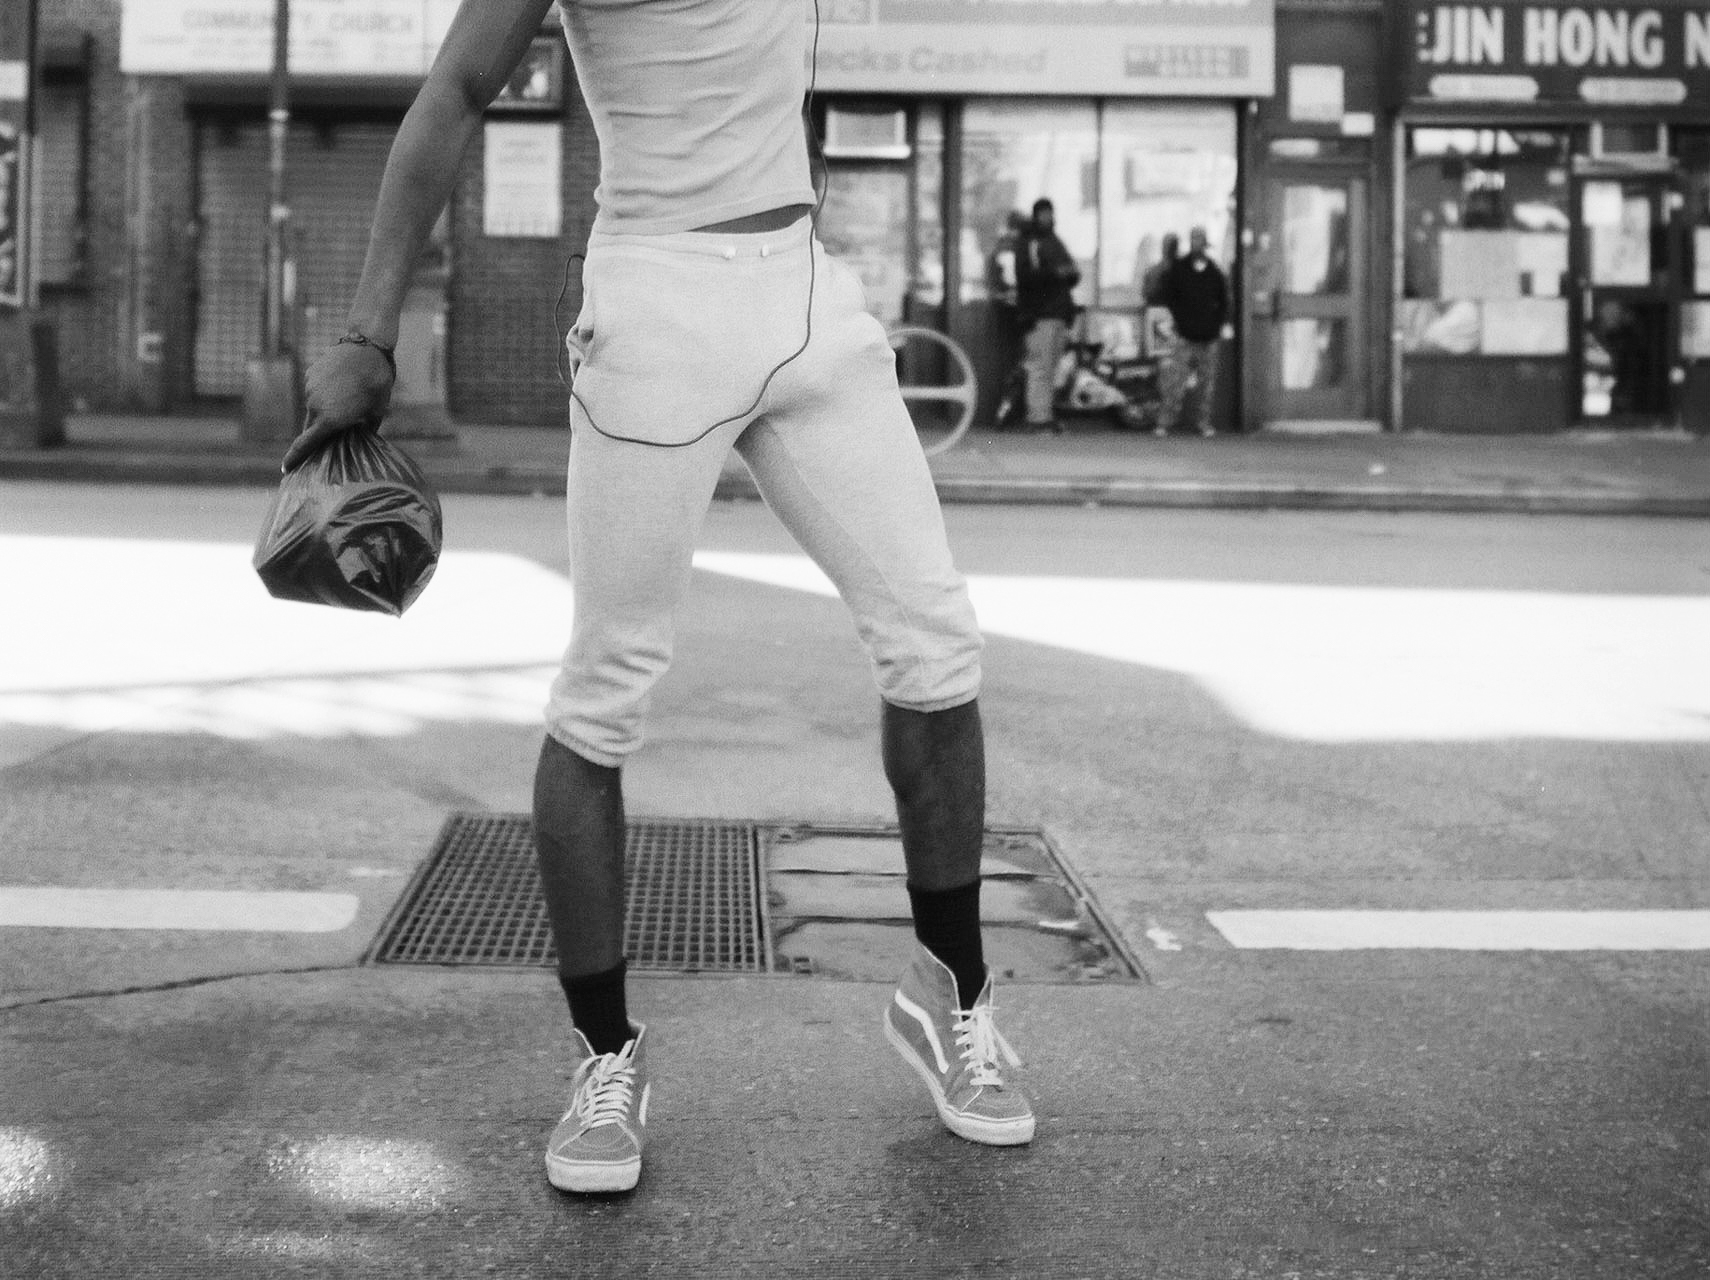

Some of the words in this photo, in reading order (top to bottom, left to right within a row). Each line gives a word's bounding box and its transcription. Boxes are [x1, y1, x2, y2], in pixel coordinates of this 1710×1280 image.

[328, 12, 413, 33] CHURCH
[1523, 6, 1665, 68] HONG
[908, 46, 1048, 74] Cashed
